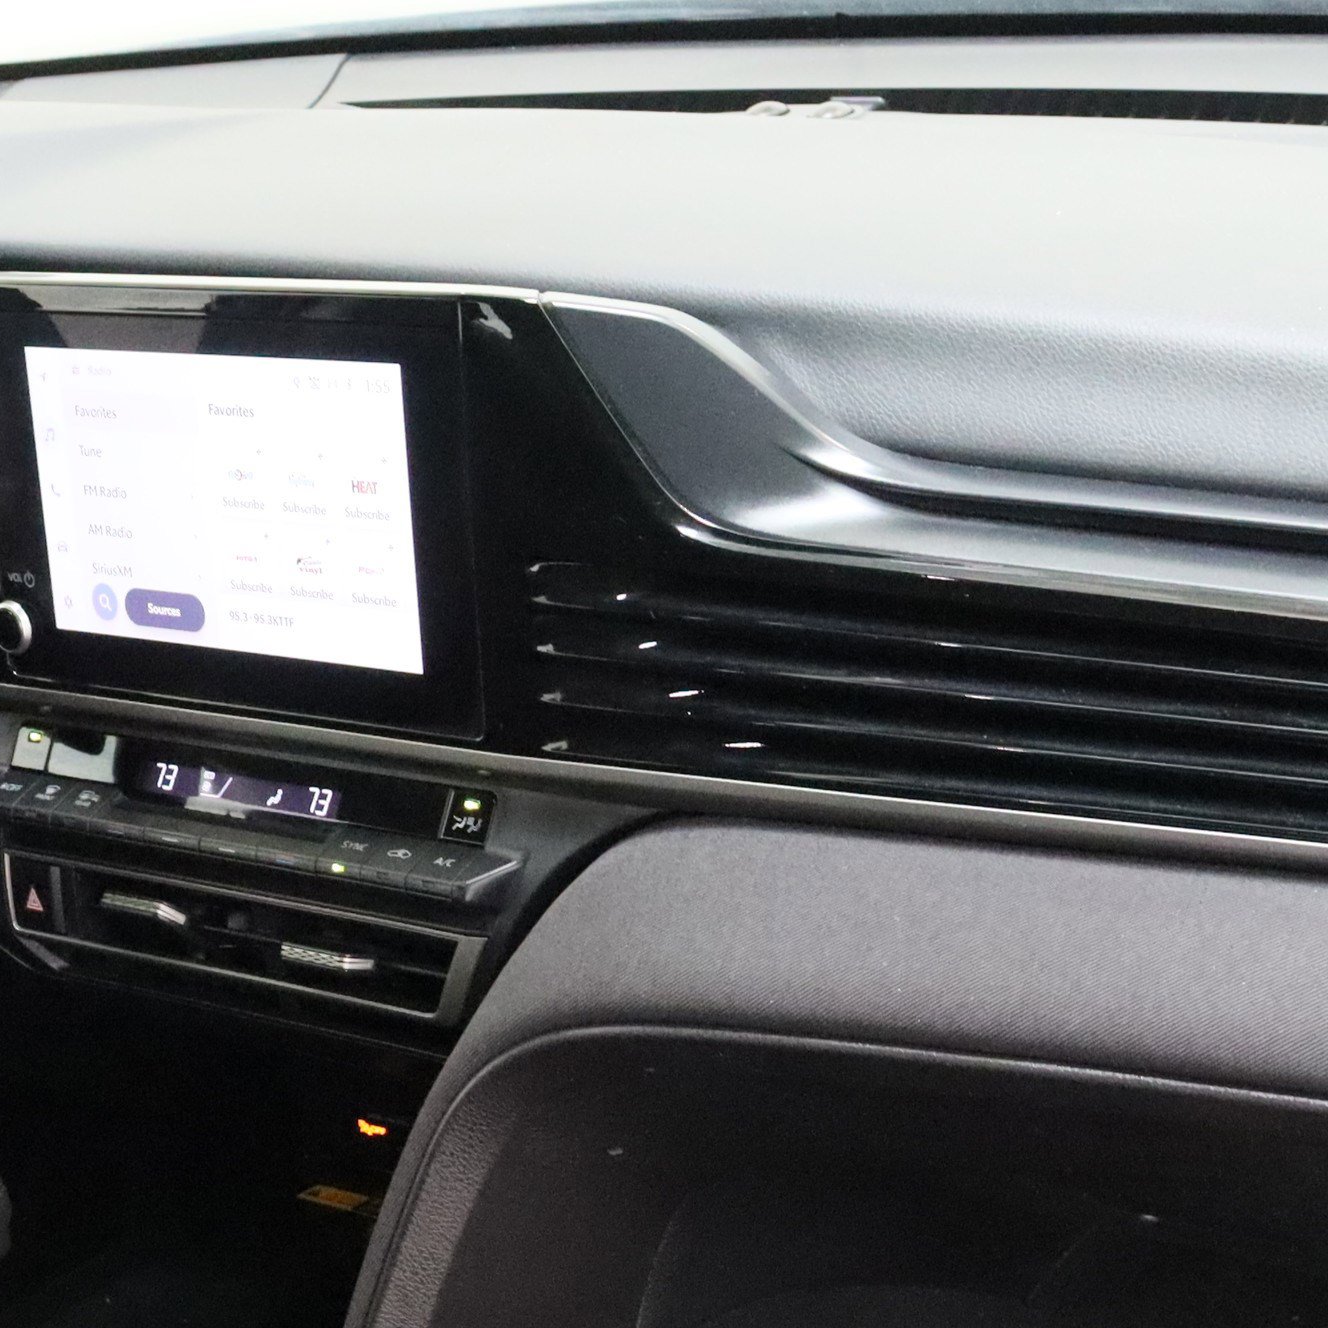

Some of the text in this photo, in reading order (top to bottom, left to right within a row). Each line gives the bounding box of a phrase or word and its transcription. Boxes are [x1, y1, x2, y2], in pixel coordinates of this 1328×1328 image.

[74, 404, 118, 420] Favorites
[208, 403, 255, 418] Favorites
[79, 444, 103, 458] Tune
[83, 484, 128, 500] FM Radio
[351, 479, 378, 494] HEAT
[222, 496, 265, 511] Subscribe
[282, 502, 327, 516] Subscribe
[344, 506, 391, 522] Subscribe
[88, 523, 133, 540] AM Radio
[92, 563, 133, 579] SiriusXM
[230, 579, 273, 594] Subscribe
[290, 585, 334, 601] Subscribe
[352, 592, 398, 608] Subscribe
[147, 602, 182, 618] Sources
[156, 762, 179, 791] 73
[308, 786, 333, 817] 73
[341, 840, 368, 852] SYNC
[433, 857, 457, 868] A/C
